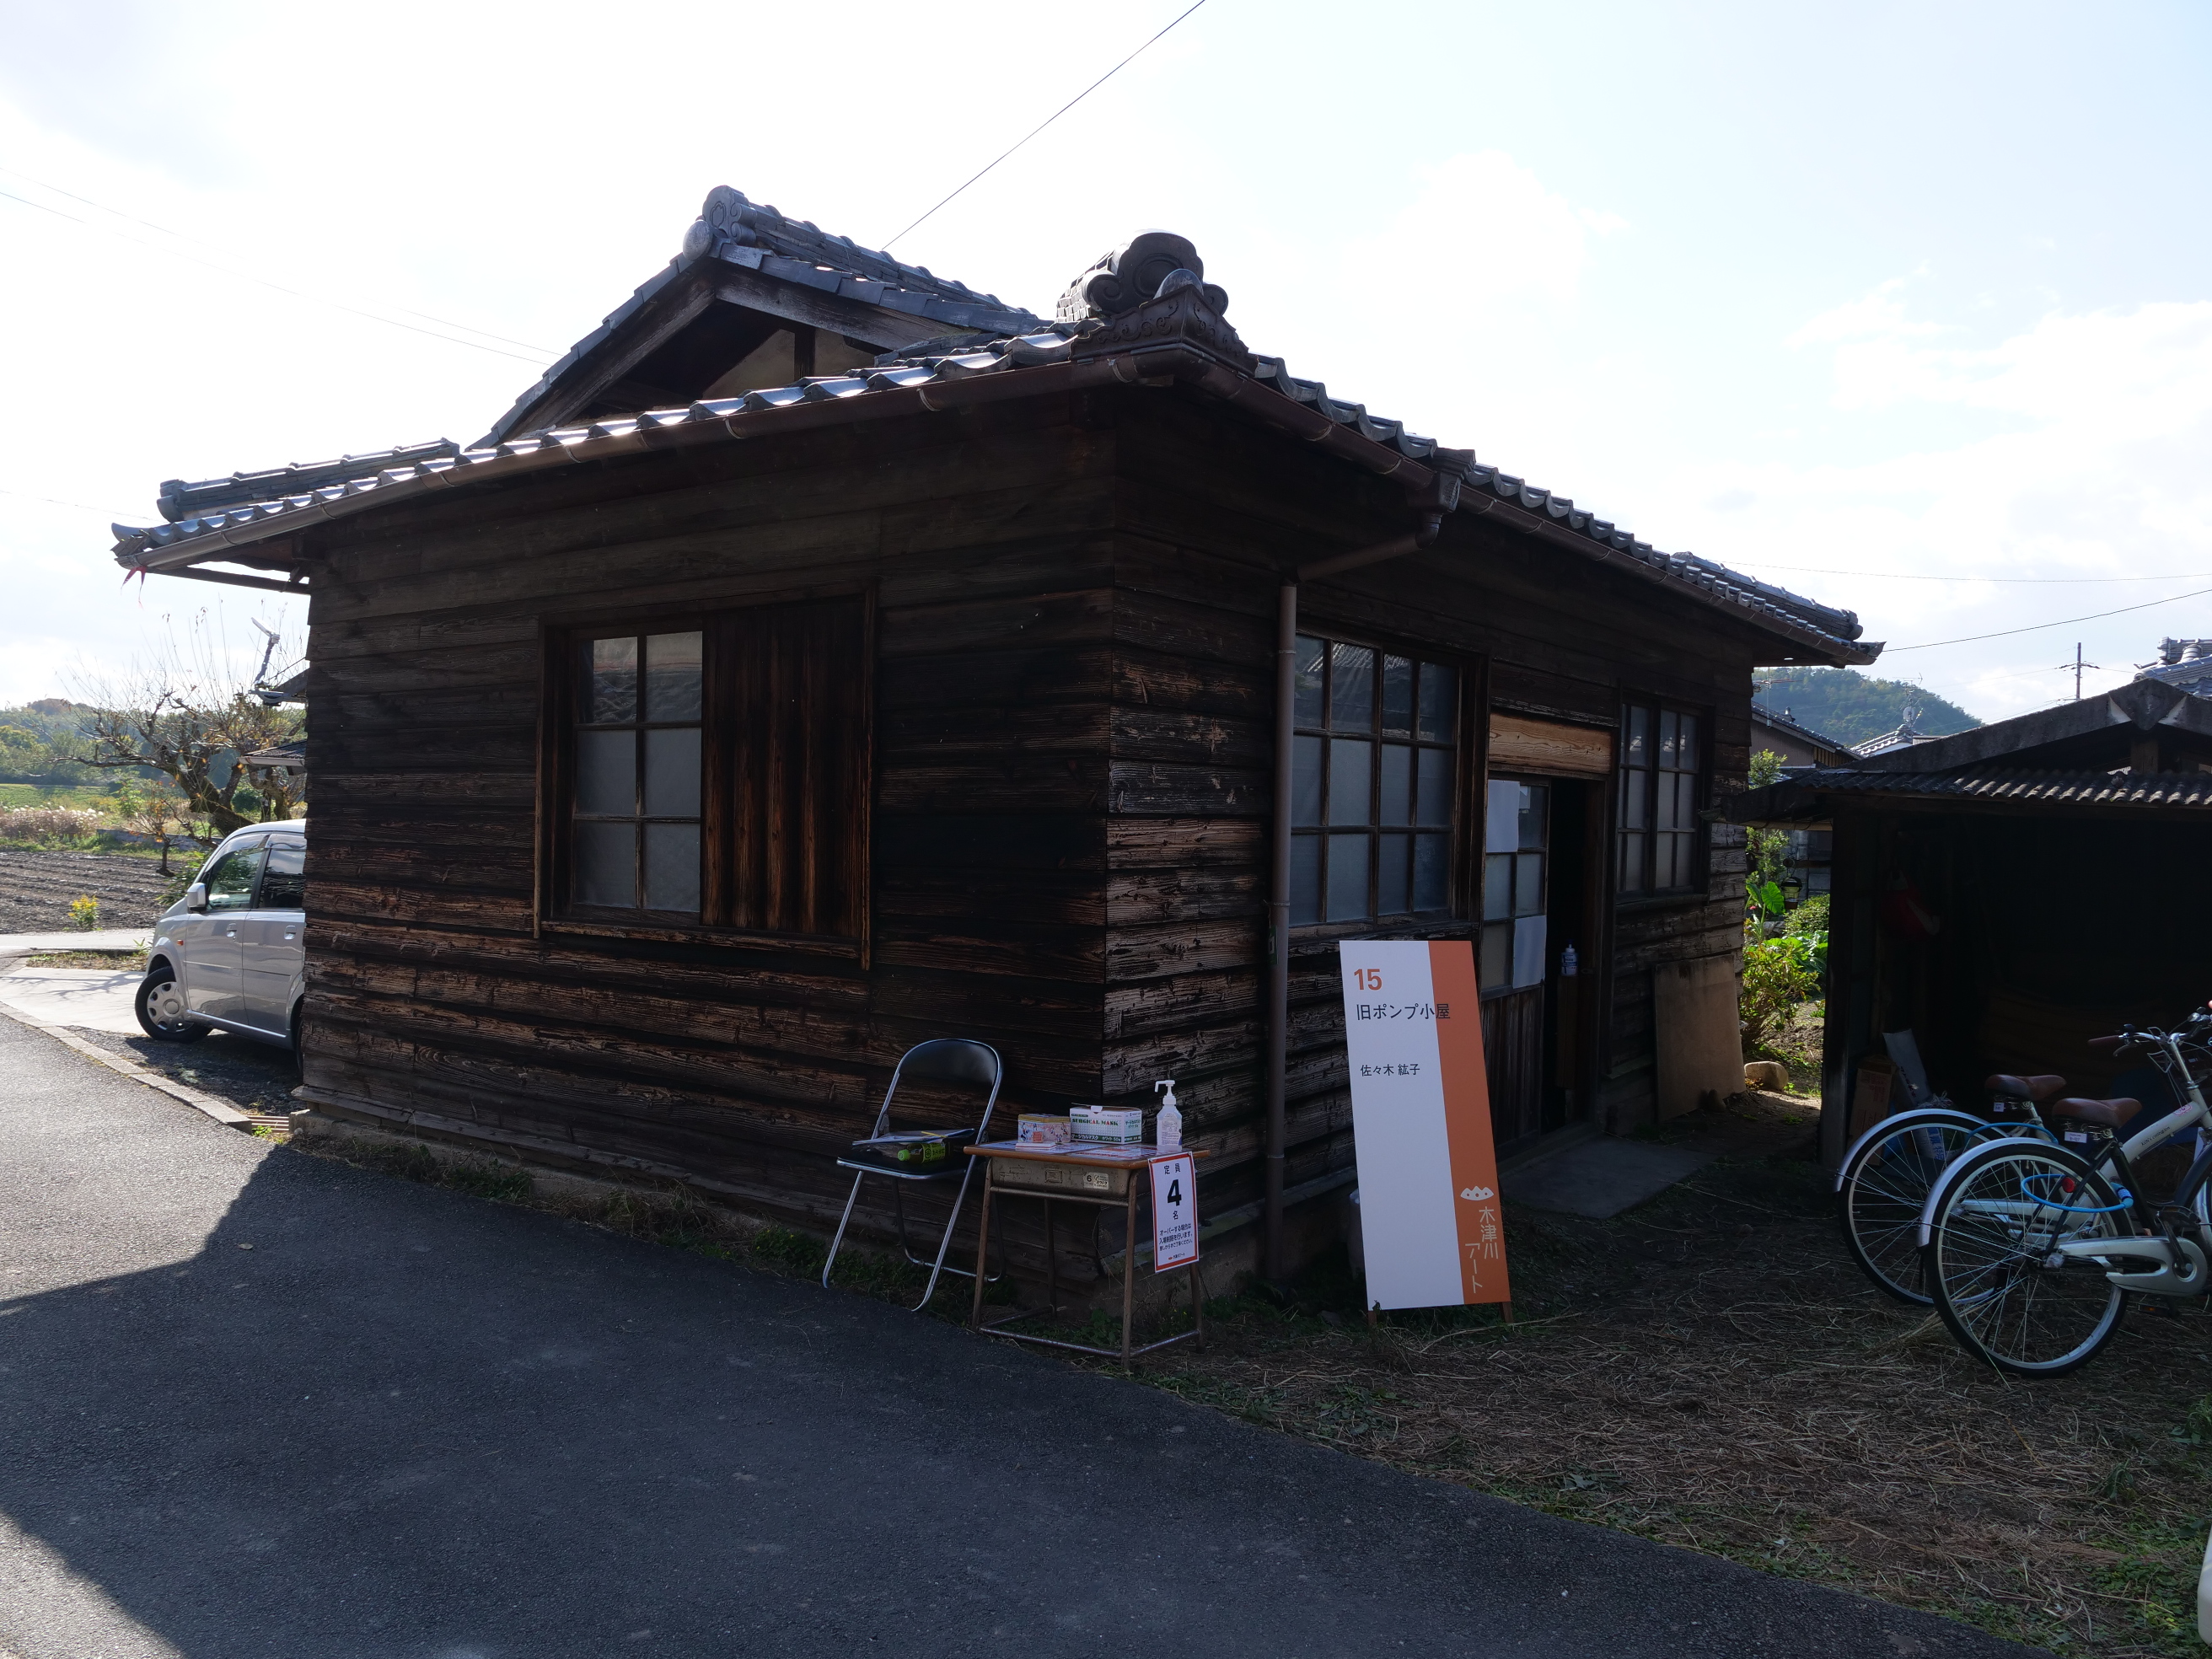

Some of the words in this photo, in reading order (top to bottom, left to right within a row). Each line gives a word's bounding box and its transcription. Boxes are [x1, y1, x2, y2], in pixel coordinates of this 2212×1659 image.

[1354, 969, 1382, 991] 15
[1356, 1003, 1451, 1021] 旧ポンプ小屋
[1360, 1064, 1394, 1076] 佐々木
[1168, 1179, 1182, 1206] 4
[1173, 1211, 1178, 1220] 名
